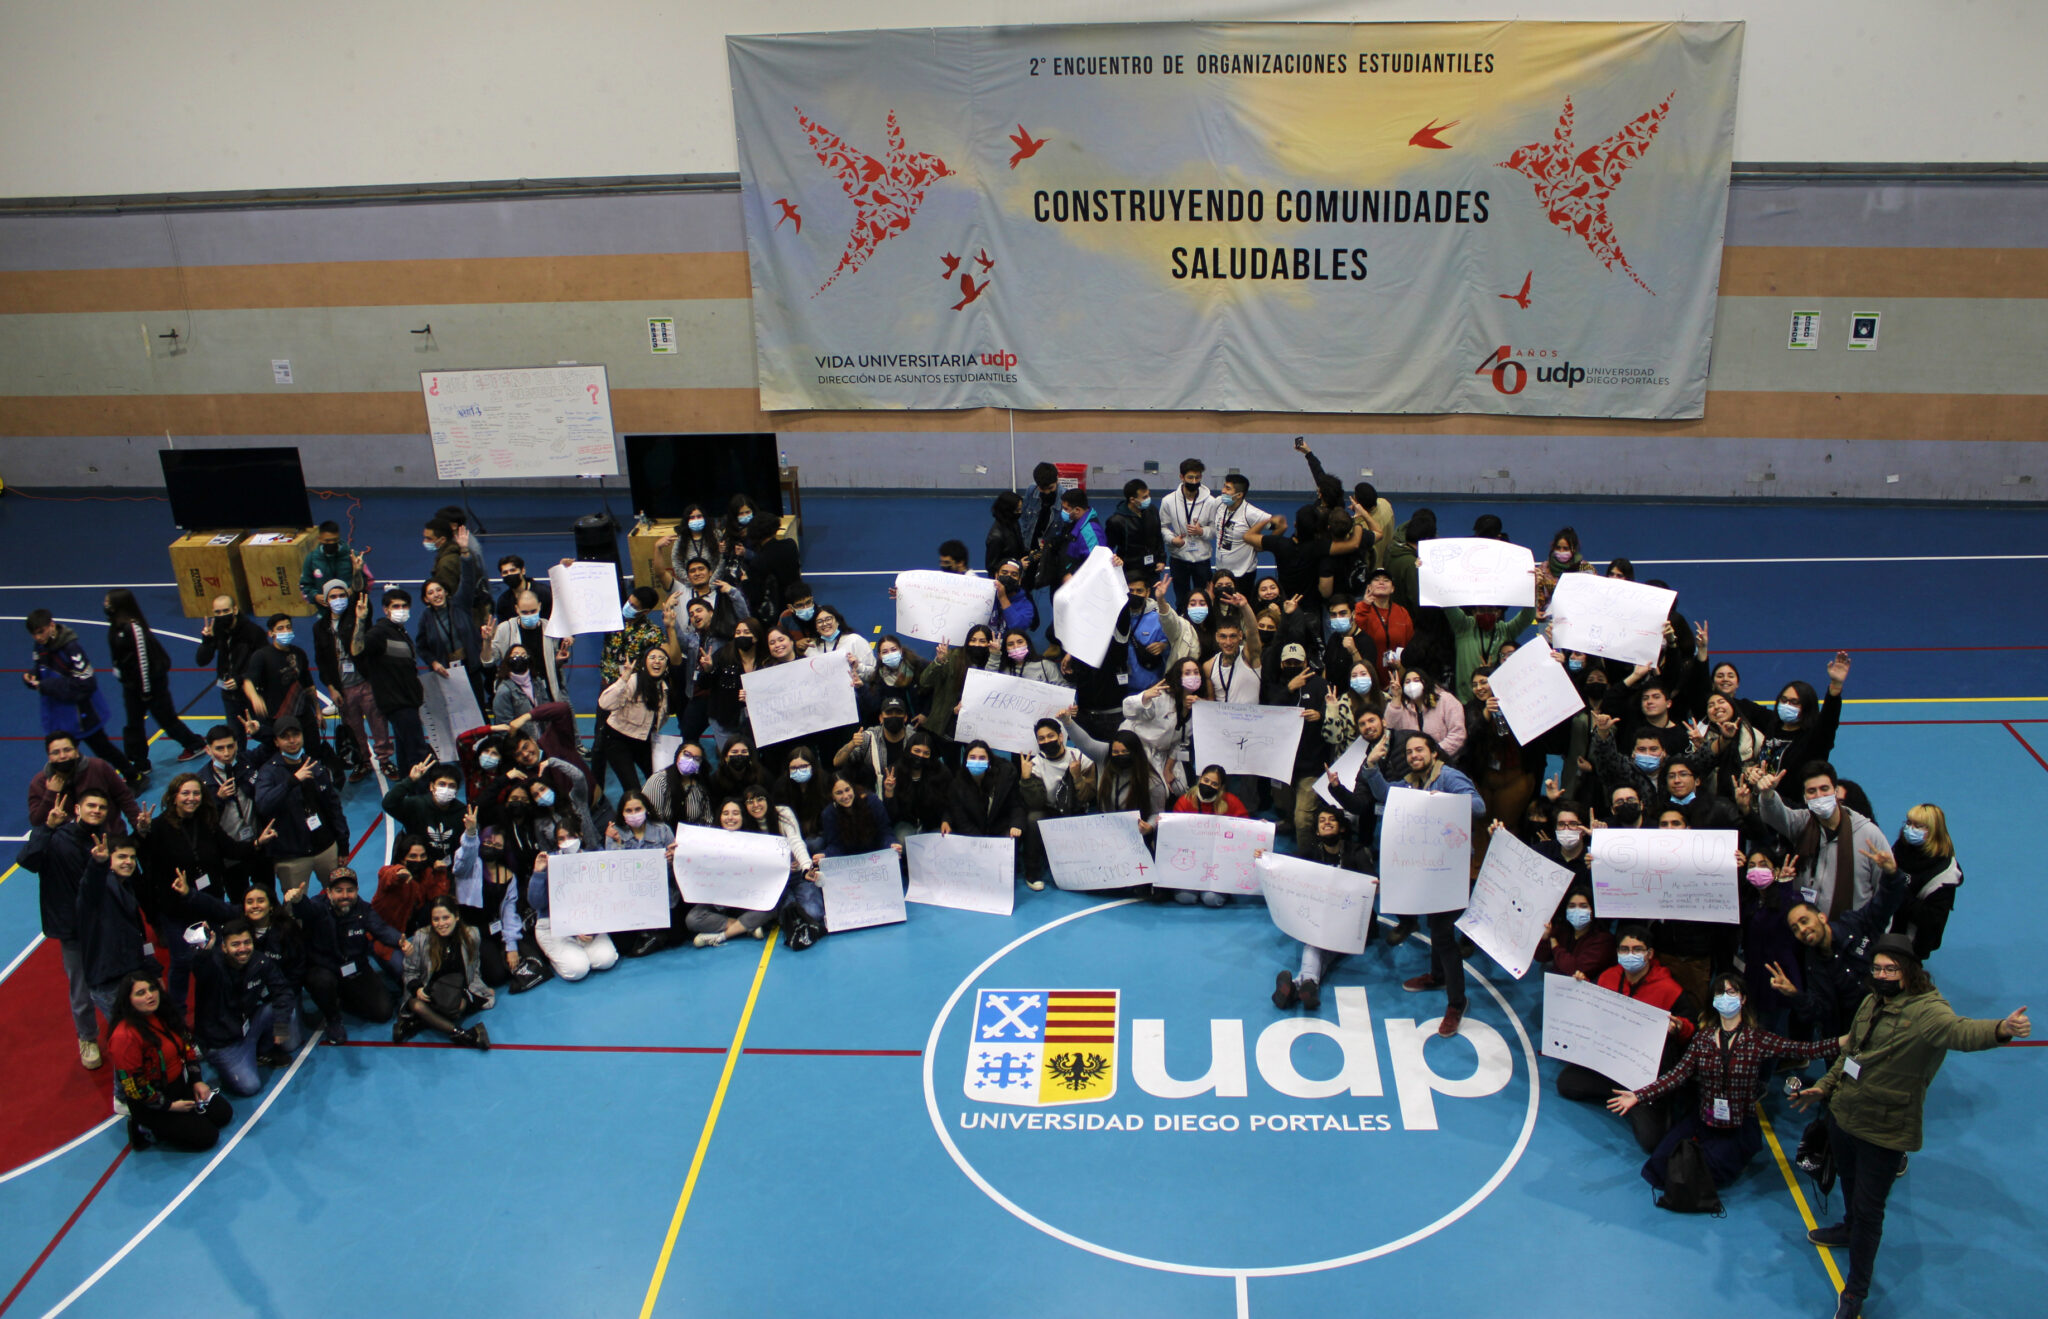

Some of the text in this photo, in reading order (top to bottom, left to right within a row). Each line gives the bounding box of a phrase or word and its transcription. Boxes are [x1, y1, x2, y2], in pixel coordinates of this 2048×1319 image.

[1053, 56, 1153, 76] ENCUENTRO
[1163, 55, 1184, 74] DE
[1197, 54, 1347, 74] ORGANIZACIONES
[1359, 53, 1494, 74] ESTUDIANTILES
[1034, 189, 1490, 223] CONSTRUYENDO COMUNIDADES
[1171, 246, 1368, 281] SALUDABLES
[815, 349, 1017, 371] VIDA UNIVERSITARIA udp
[1516, 348, 1558, 358] AÑOS
[818, 373, 1018, 385] DIRECCIÓN DE ASUNTOS ESTUDIANTILES
[1474, 345, 1528, 395] 40
[1536, 361, 1585, 388] udp
[1587, 367, 1655, 378] UNIVERSIDAD
[1586, 376, 1670, 387] DIEGO PORTALES
[1131, 985, 1514, 1131] udp
[960, 1112, 1392, 1132] UNIVERSIDAD DIEGO PORTALES
